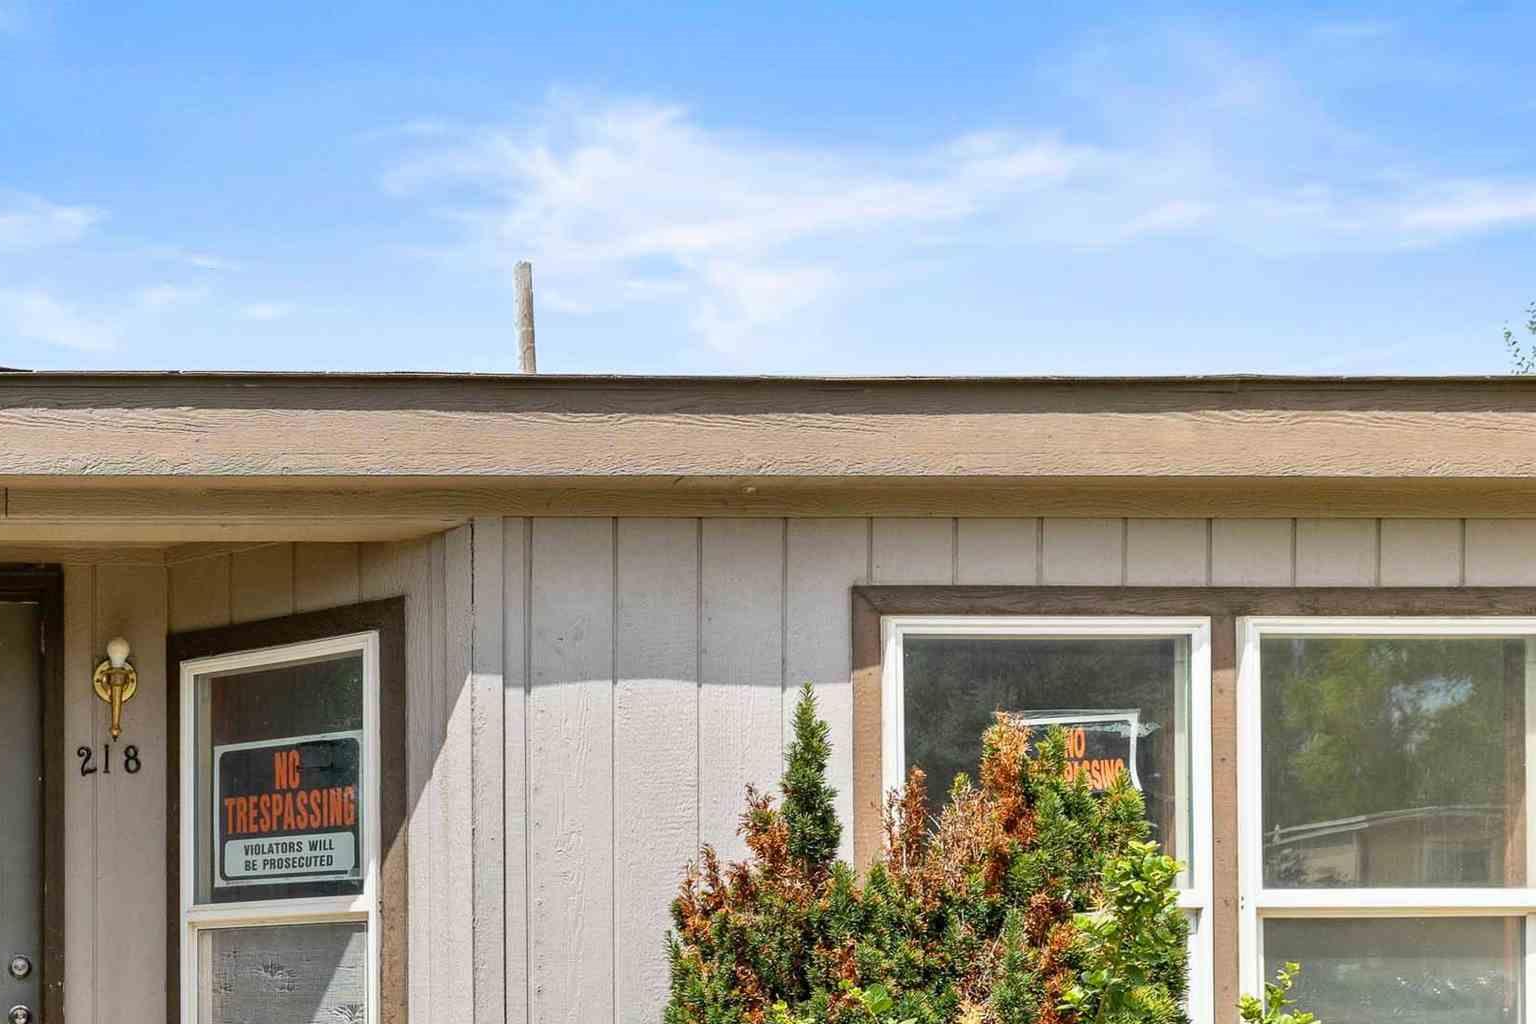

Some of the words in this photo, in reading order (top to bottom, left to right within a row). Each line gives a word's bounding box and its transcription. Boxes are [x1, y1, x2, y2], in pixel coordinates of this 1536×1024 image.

[77, 744, 142, 777] 218
[274, 750, 301, 790] NO
[224, 784, 356, 834] TRESPASSING
[244, 841, 303, 856] VIOLATORS
[308, 839, 335, 851] WILL
[244, 860, 257, 872] BE
[262, 855, 334, 871] PROSECUTED
